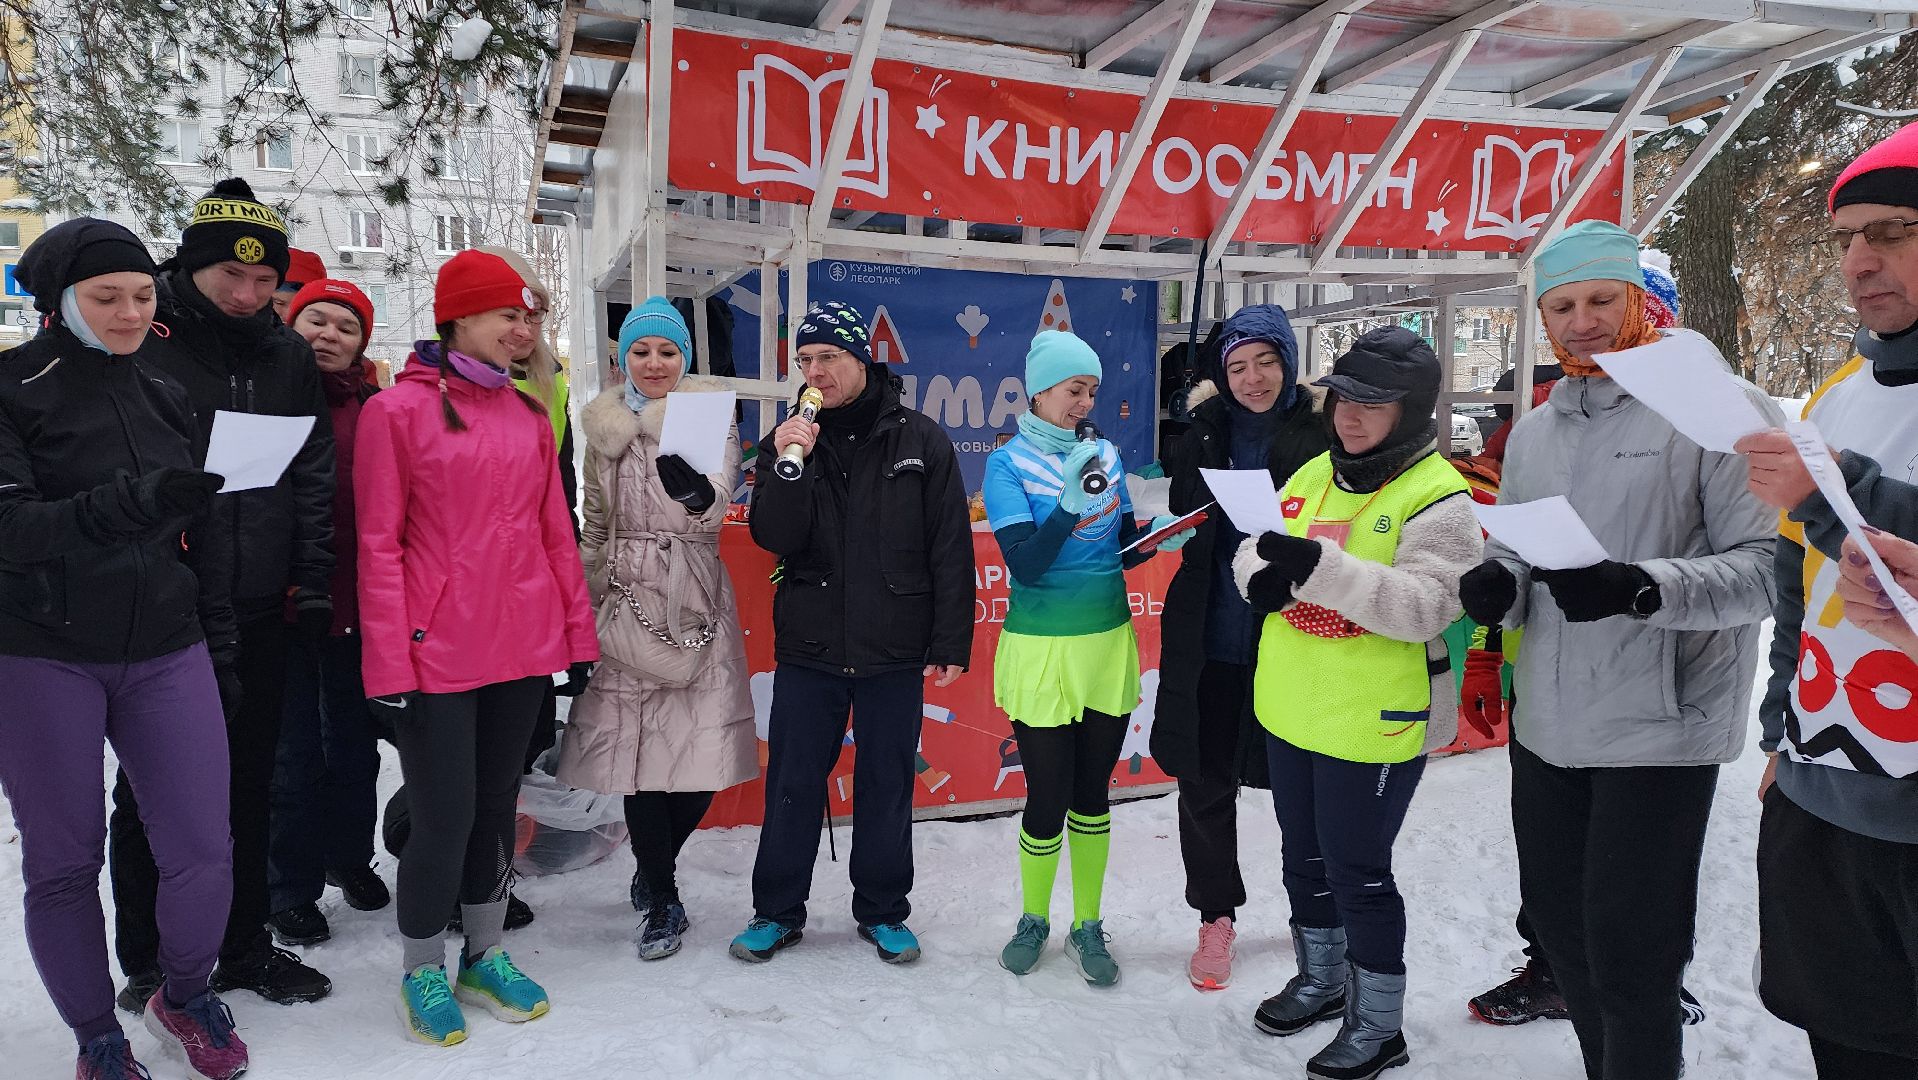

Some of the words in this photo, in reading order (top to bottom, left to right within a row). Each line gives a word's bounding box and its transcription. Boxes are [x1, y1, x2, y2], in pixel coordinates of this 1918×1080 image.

[963, 115, 1418, 210] КНИООБМЕН
[240, 240, 261, 256] BVB
[849, 263, 921, 276] КУЗЬМИНСКИЙ
[850, 274, 901, 285] ЛЕСОПАРК
